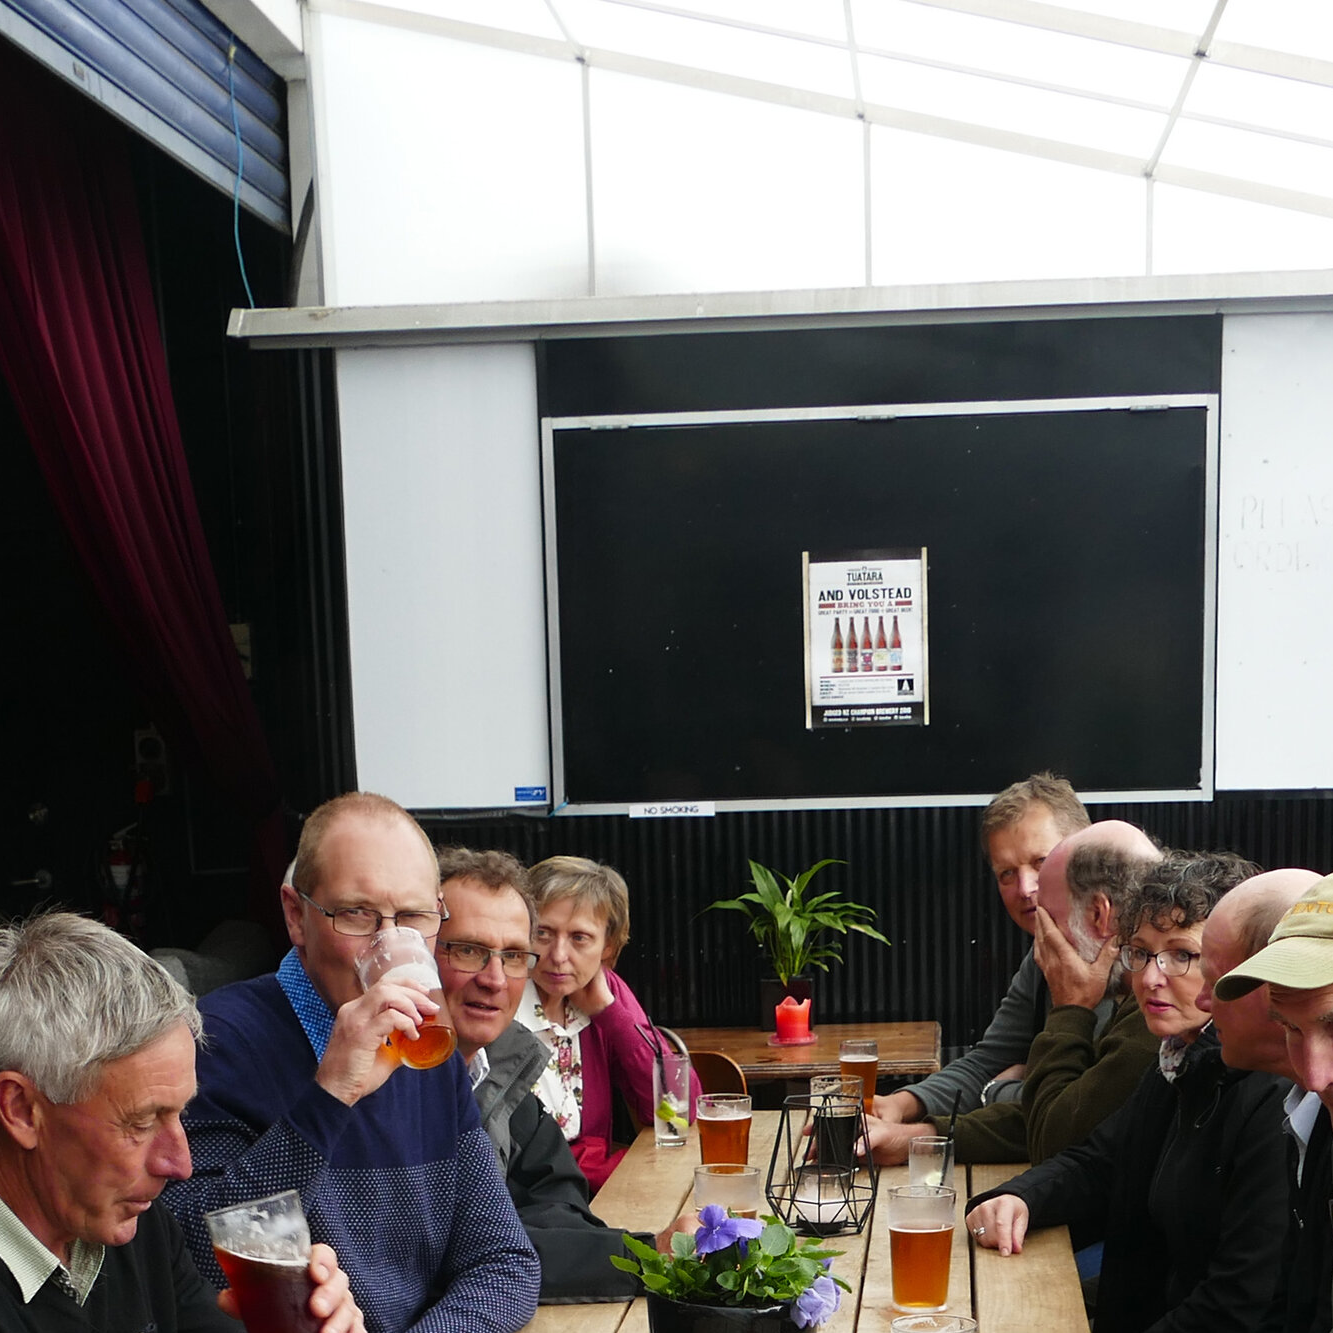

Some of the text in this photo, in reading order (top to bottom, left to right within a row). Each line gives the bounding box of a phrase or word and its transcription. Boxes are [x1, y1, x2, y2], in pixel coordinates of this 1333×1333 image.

[847, 571, 883, 582] TUATARA
[818, 587, 912, 601] AND VOLSTEAD
[837, 601, 865, 609] BRING
[867, 600, 886, 608] YOU
[644, 805, 699, 815] NO SMOKING
